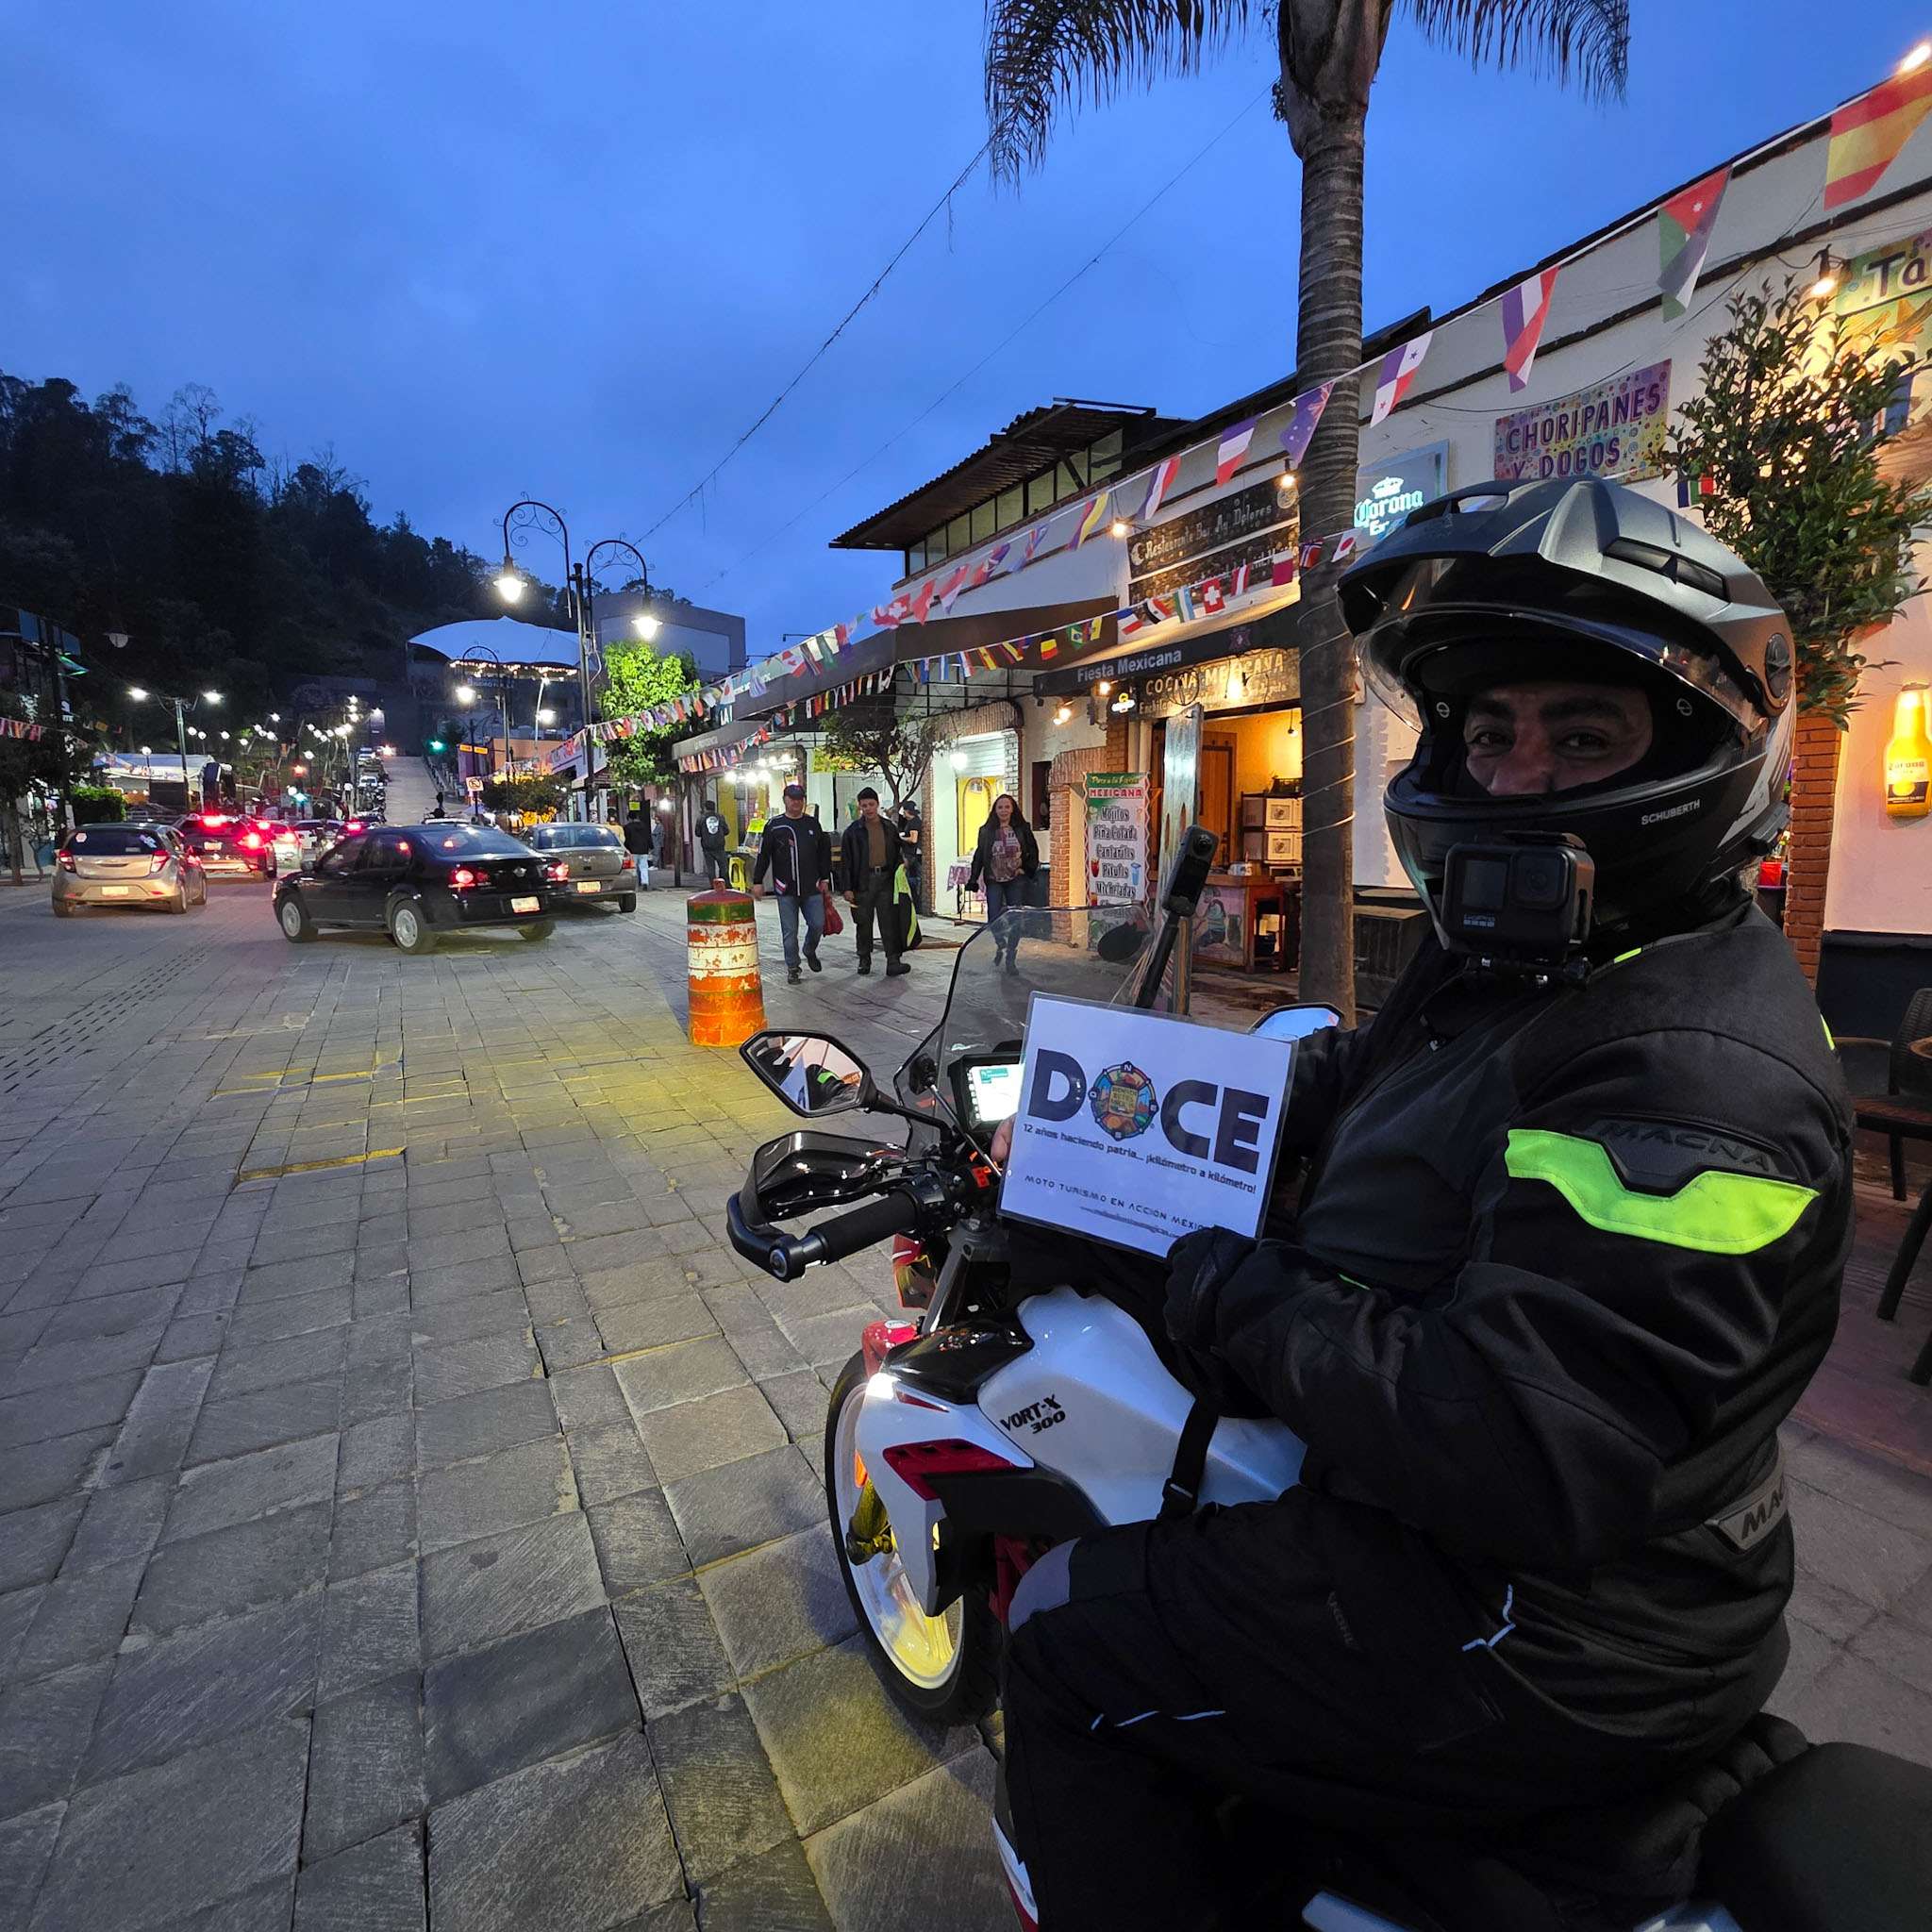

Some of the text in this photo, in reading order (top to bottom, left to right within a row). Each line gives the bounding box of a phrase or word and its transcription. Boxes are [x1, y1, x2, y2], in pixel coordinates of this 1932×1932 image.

[1507, 382, 1661, 453] CHORIPANES
[1513, 437, 1621, 480] Y DOGOS
[1233, 504, 1273, 526] Dolores
[1354, 490, 1424, 528] Corona
[1077, 649, 1182, 683] Fiesta Mexicana
[1145, 653, 1285, 695] COCINA MECANA
[1090, 789, 1142, 797] MEXICANA
[1641, 798, 1701, 825] SCHUBERTH
[1101, 806, 1130, 824] Mojitos
[1023, 1124, 1033, 1133] 12
[1035, 1127, 1058, 1140] años
[1060, 1130, 1105, 1151] haciendo
[1199, 1169, 1206, 1177] a
[1208, 1170, 1257, 1194] kilómetro!
[1600, 1122, 1771, 1172] MACNA
[1024, 1174, 1055, 1189] MOTO
[1059, 1183, 1107, 1203] TURISMO
[1110, 1197, 1124, 1208] EN
[999, 1393, 1061, 1432] VORT-X
[1030, 1409, 1066, 1435] 300
[1741, 1475, 1784, 1541] MA
